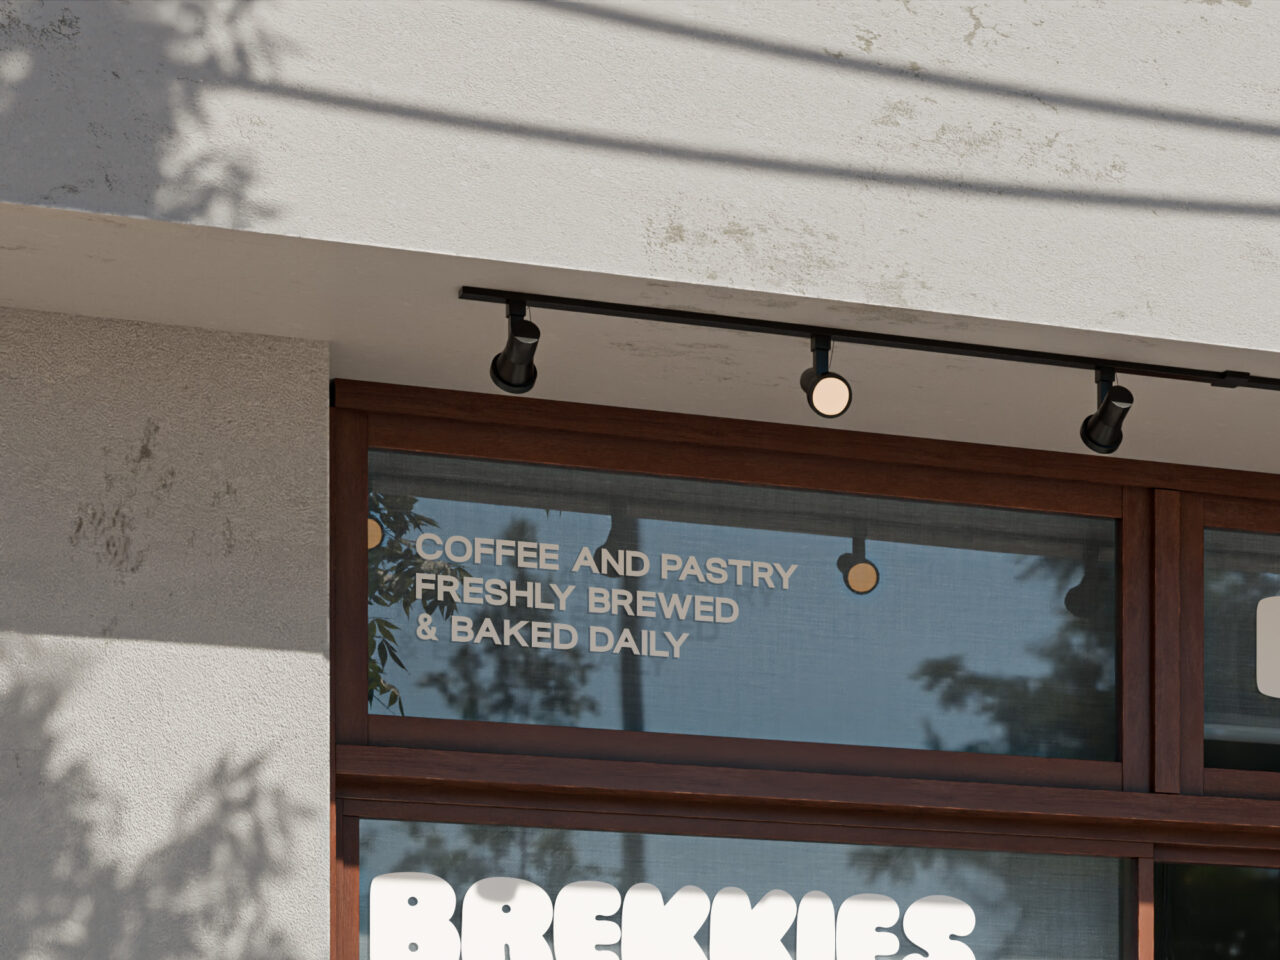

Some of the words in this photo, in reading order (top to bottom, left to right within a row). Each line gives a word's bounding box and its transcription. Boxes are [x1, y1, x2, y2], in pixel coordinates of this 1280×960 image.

[415, 533, 560, 571] COFFEE
[571, 546, 651, 577] AND
[660, 553, 798, 590] PASTRY
[415, 572, 576, 611] FRESHLY
[588, 587, 740, 624] BREWED
[416, 612, 439, 641] &
[451, 615, 578, 650] BAKED
[589, 625, 690, 659] DAILY
